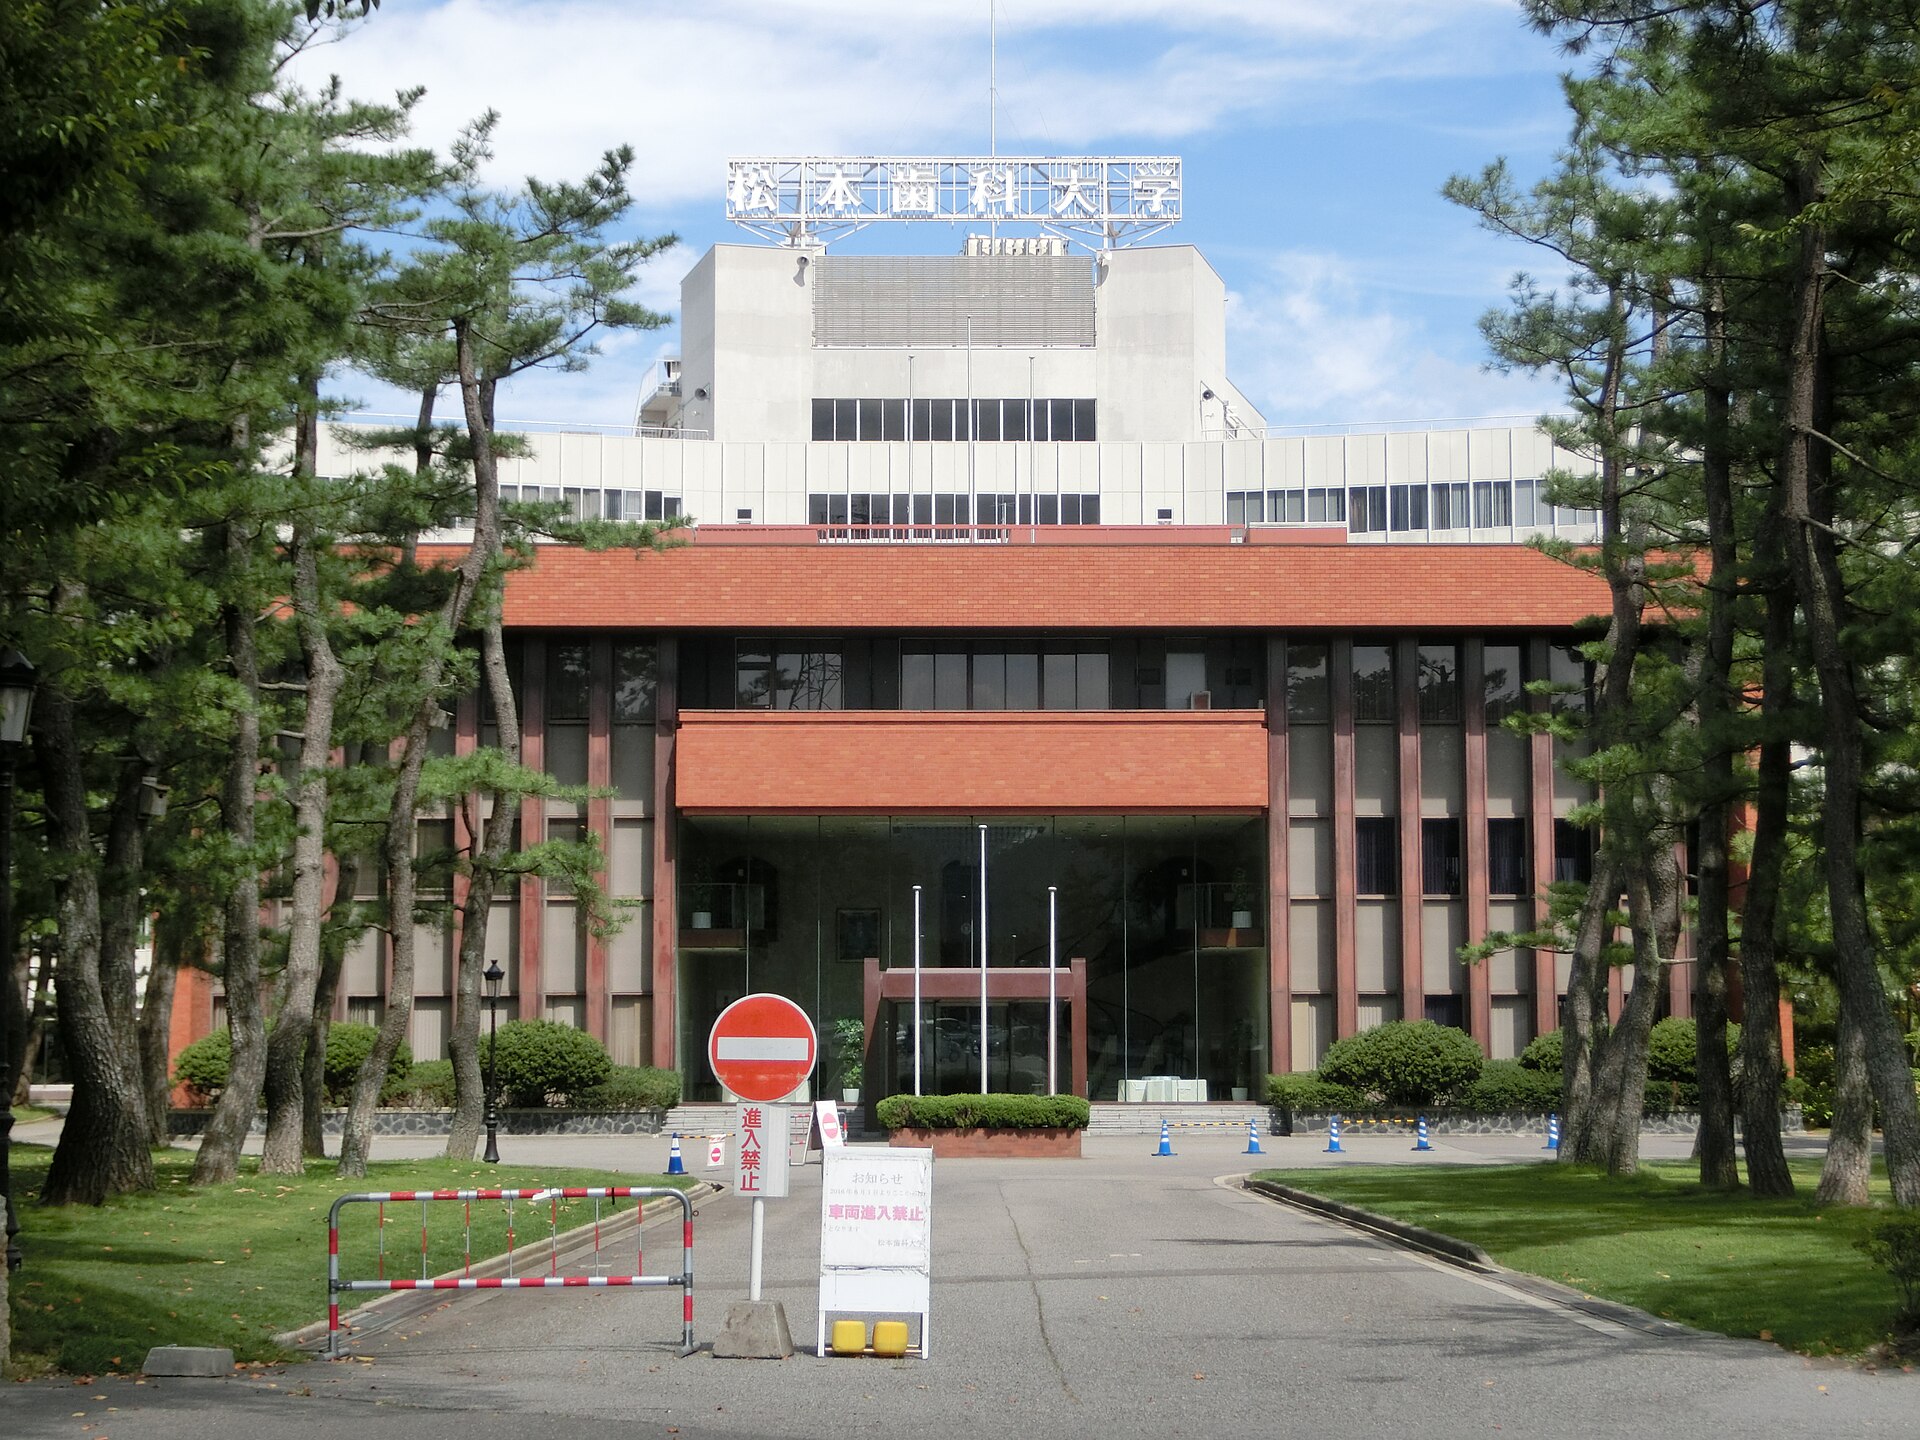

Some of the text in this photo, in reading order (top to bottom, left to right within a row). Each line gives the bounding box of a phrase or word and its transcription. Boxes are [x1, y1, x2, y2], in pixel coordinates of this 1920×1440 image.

[728, 163, 1179, 213] 松本歯科大学
[740, 1107, 762, 1191] 進入禁止
[852, 1172, 903, 1184] お知らせ
[829, 1204, 924, 1221] 車両進入禁止
